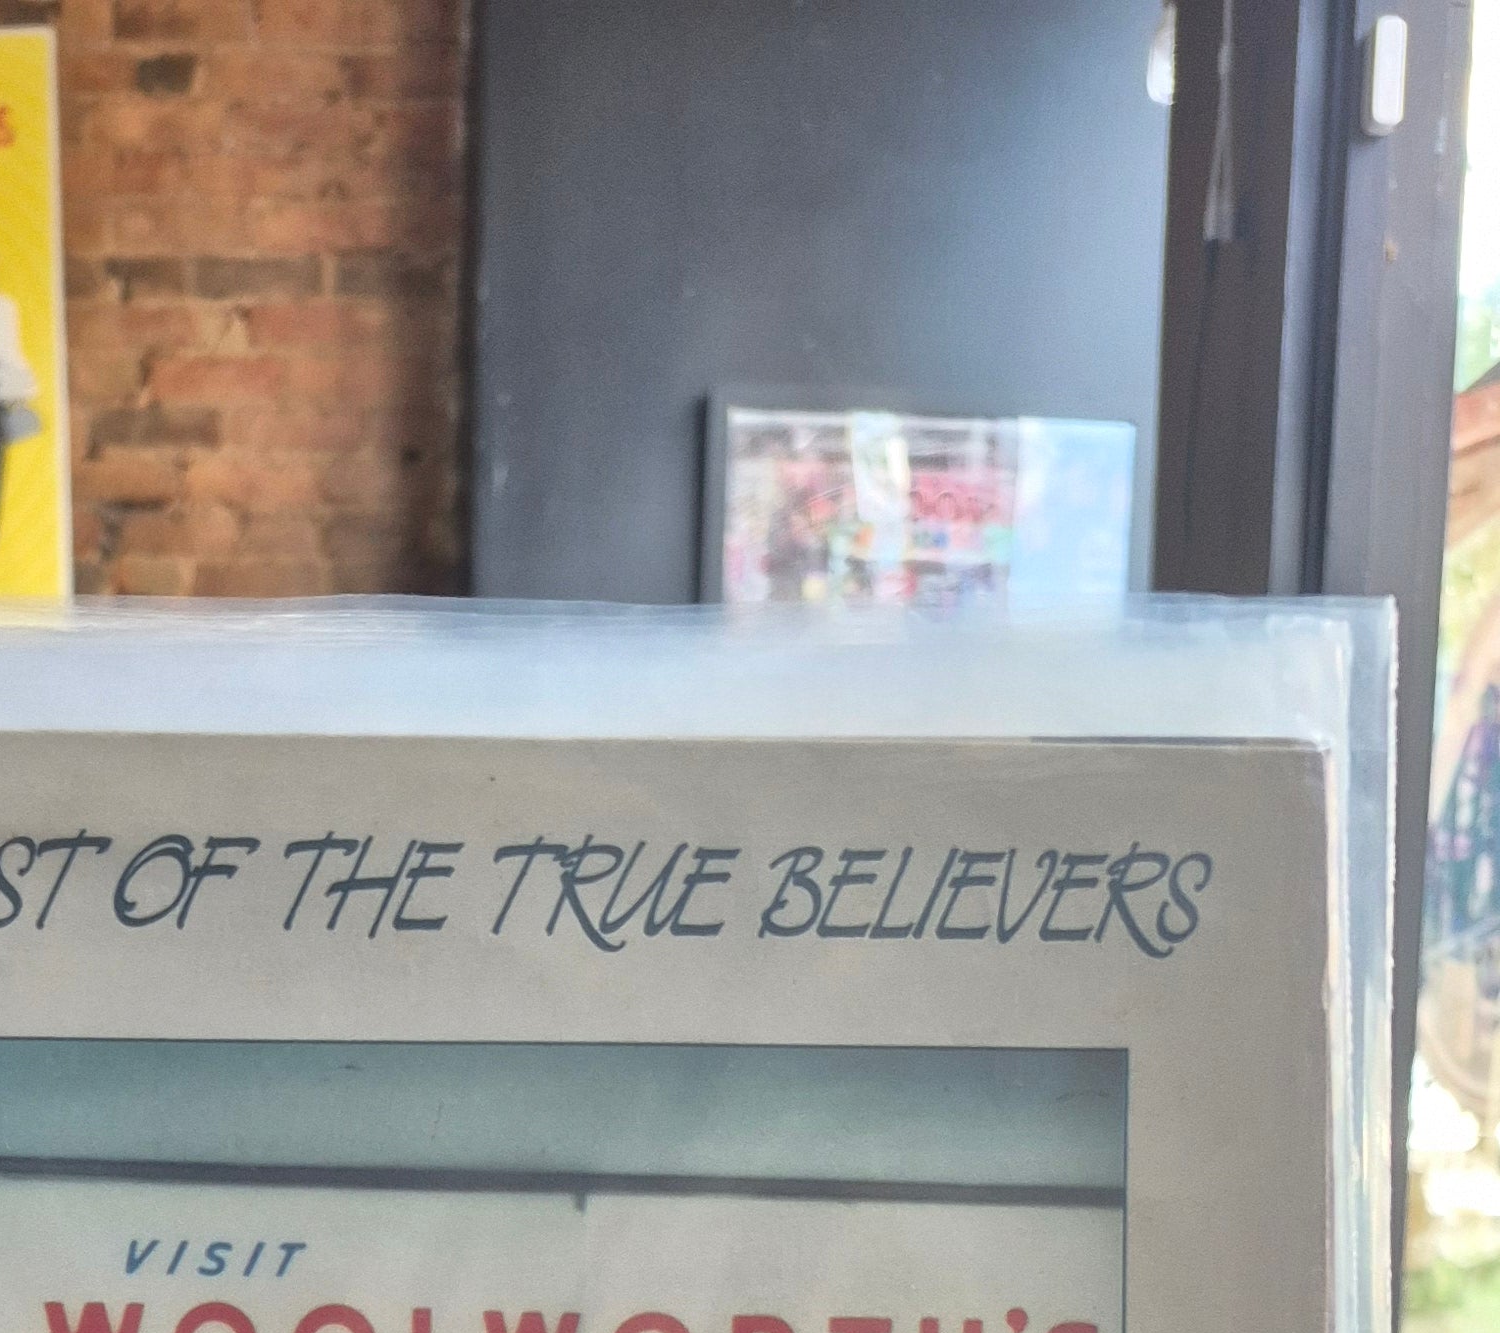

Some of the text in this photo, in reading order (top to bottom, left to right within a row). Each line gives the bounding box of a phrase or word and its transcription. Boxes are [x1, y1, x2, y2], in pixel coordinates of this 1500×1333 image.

[112, 833, 262, 931] OF
[282, 831, 465, 939] THE
[490, 834, 743, 953] TRUE
[756, 841, 1214, 959] BELIEVERS
[122, 1238, 308, 1279] VISIT
